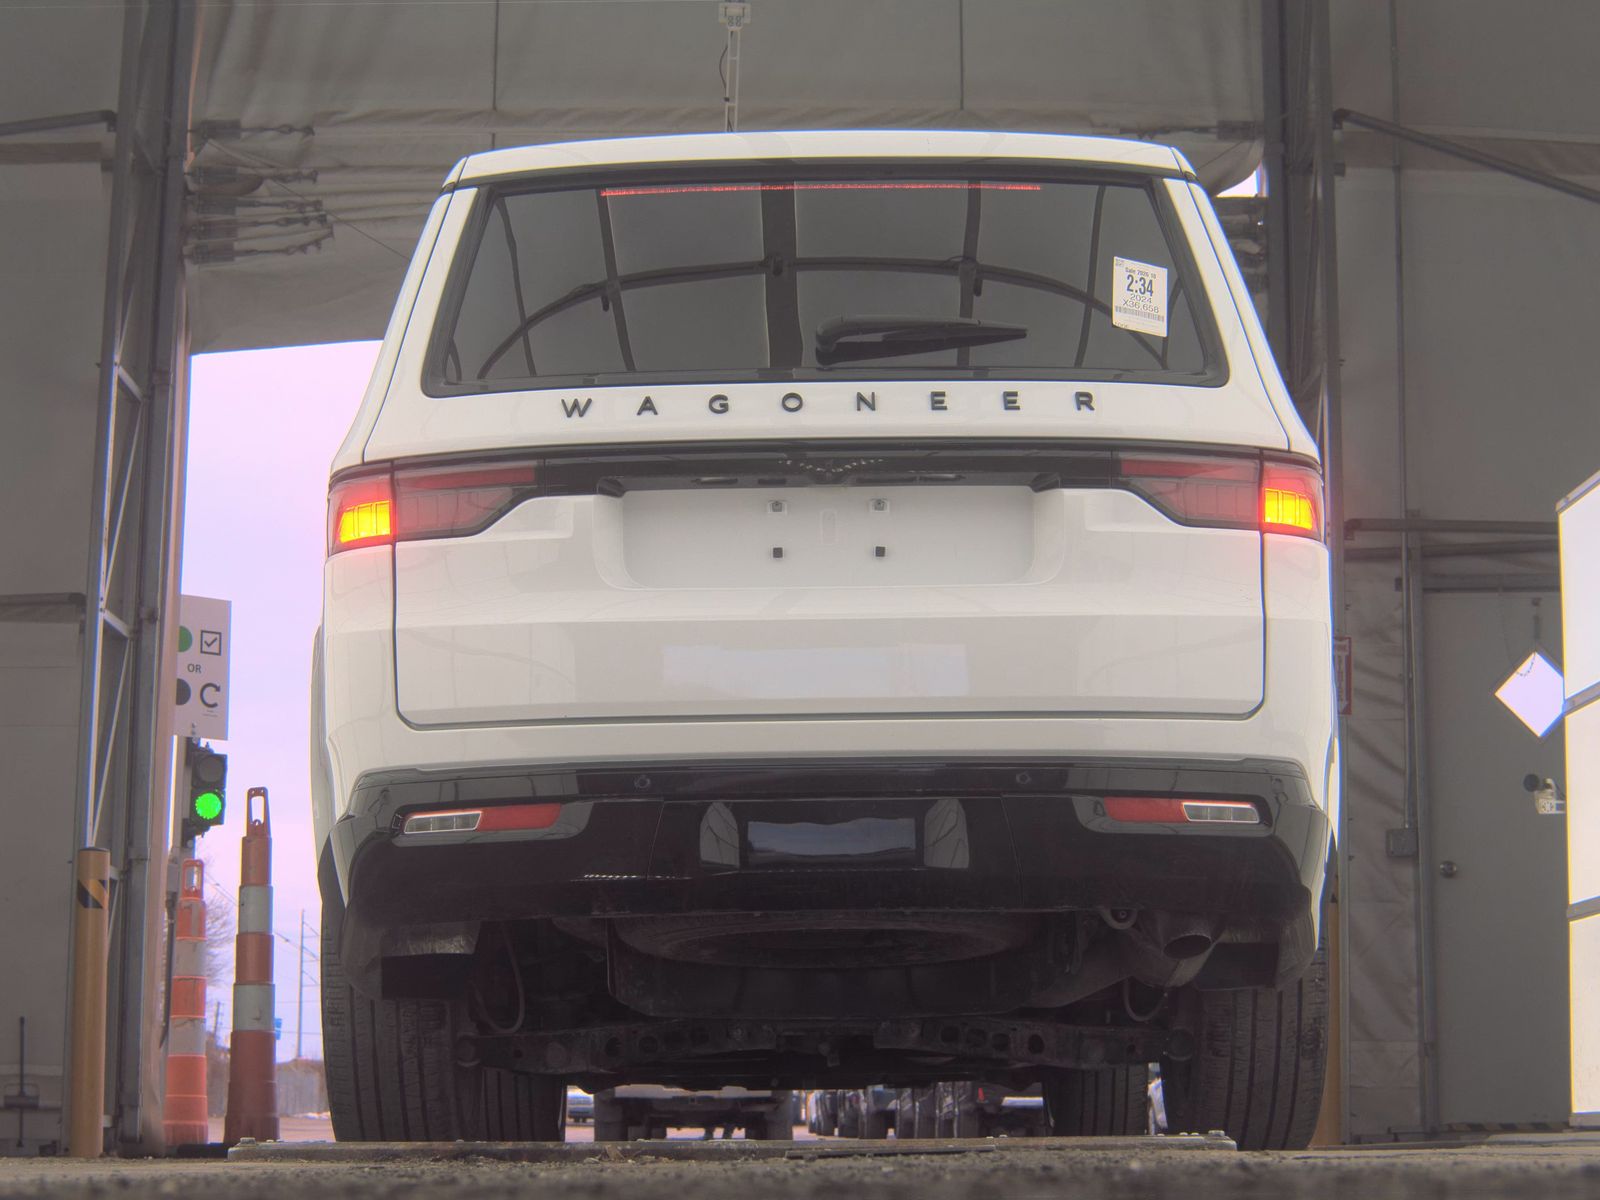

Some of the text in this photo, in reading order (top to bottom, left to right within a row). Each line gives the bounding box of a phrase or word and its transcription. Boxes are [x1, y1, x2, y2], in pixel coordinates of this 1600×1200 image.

[1126, 274, 1153, 296] 2:34
[1130, 293, 1152, 303] 2024
[561, 391, 1095, 418] WAGONEER
[187, 663, 202, 674] OR
